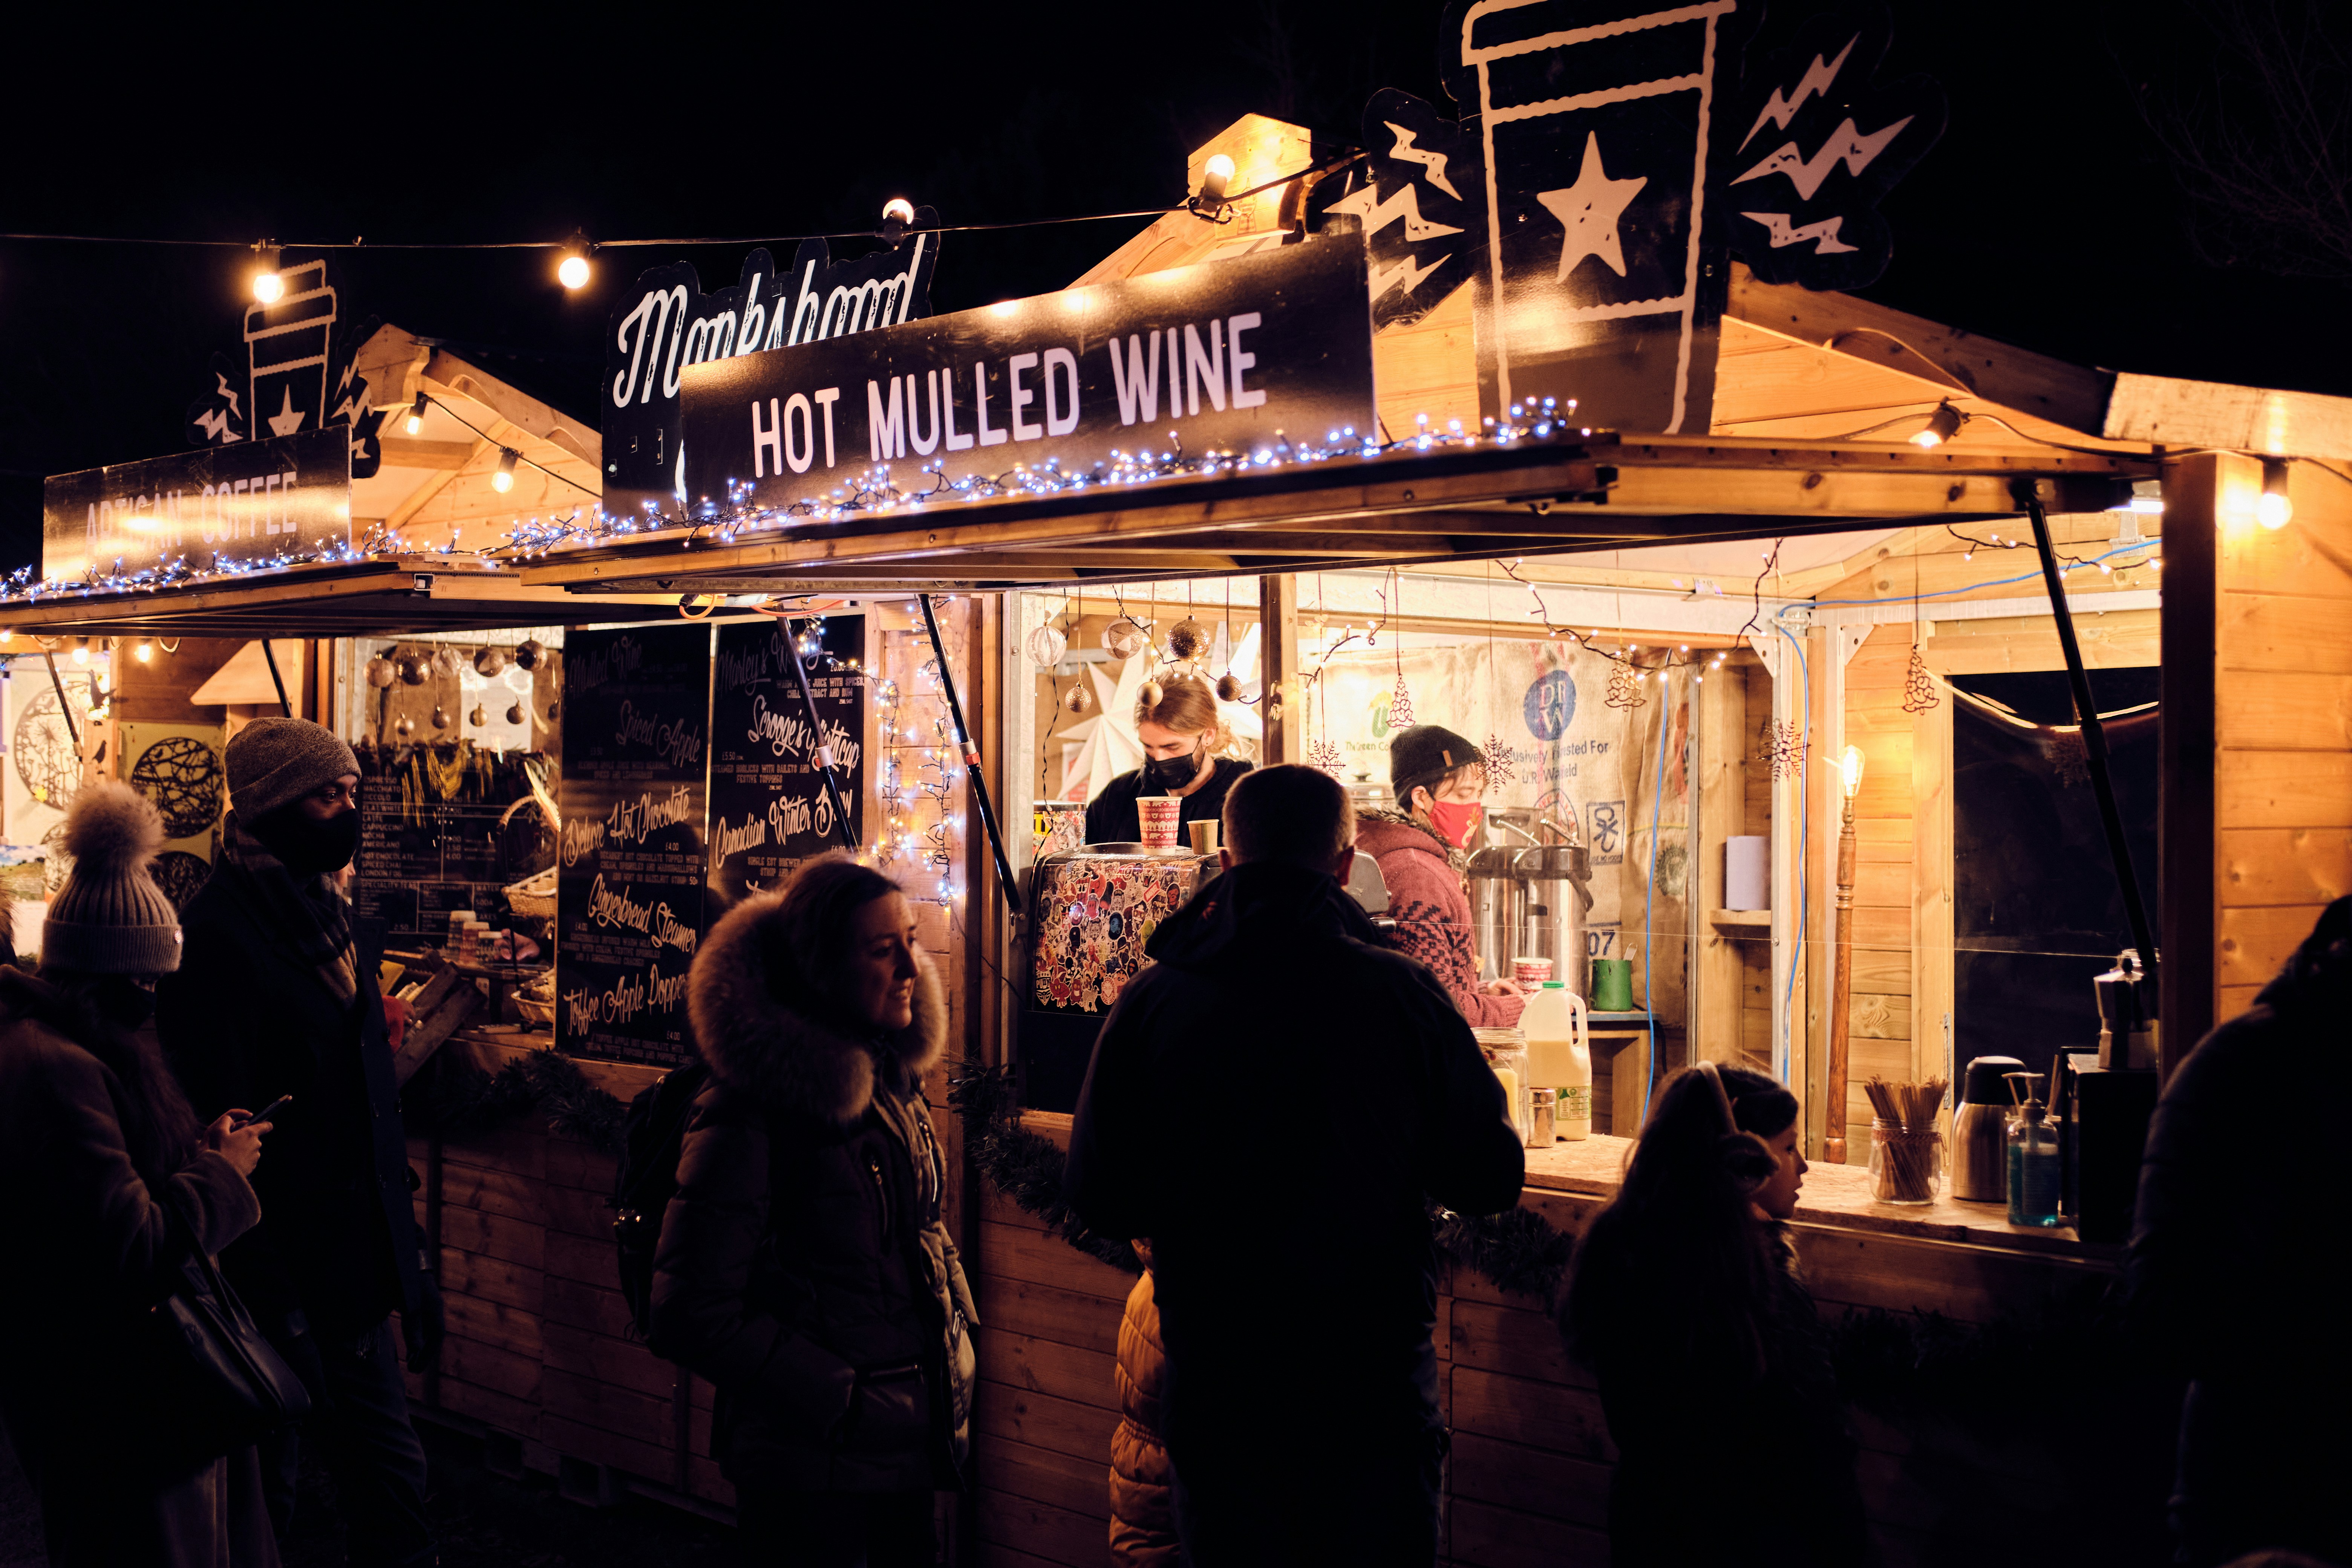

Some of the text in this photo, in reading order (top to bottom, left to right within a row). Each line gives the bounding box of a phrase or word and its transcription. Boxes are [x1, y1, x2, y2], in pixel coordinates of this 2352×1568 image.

[752, 311, 1266, 478] HOT MULLED WINE
[201, 471, 297, 544] COFFEE
[569, 635, 642, 700] Mulled Wine
[717, 639, 771, 700] Marley's
[813, 678, 827, 687] JUICE
[830, 677, 843, 686] WITH
[787, 689, 801, 698] CHILL
[830, 688, 840, 697] AND
[842, 688, 853, 697] RUM
[616, 699, 701, 768] Spiced Apple
[747, 694, 860, 779] Scrooge's Nghtcap
[1345, 741, 1355, 751] The
[1357, 742, 1376, 751] Green
[1590, 740, 1609, 754] For
[722, 751, 735, 761] £5.50
[761, 764, 775, 773] WITH
[776, 764, 797, 773] BAILEYS
[799, 764, 810, 773] AND
[364, 776, 397, 784] ESPRESSO
[737, 775, 783, 784] FESTIVE TOPPINGS
[362, 823, 404, 831] CAPPUCCINO
[564, 784, 691, 868] Deluxe Hot Chocolate
[715, 782, 853, 869] Canadian Winter Bw
[665, 841, 679, 851] £4.00
[375, 853, 414, 861] CHOCOLATE
[636, 852, 663, 862] CHOCOLATE
[665, 853, 683, 863] TOPPED
[685, 854, 699, 864] WITH
[588, 872, 697, 955] Gingerbread Steamer
[575, 922, 588, 932] £4.00
[1588, 931, 1615, 956] 07
[563, 987, 600, 1037] Toffee
[603, 973, 644, 1024] Apple
[666, 1031, 680, 1041] £4.00
